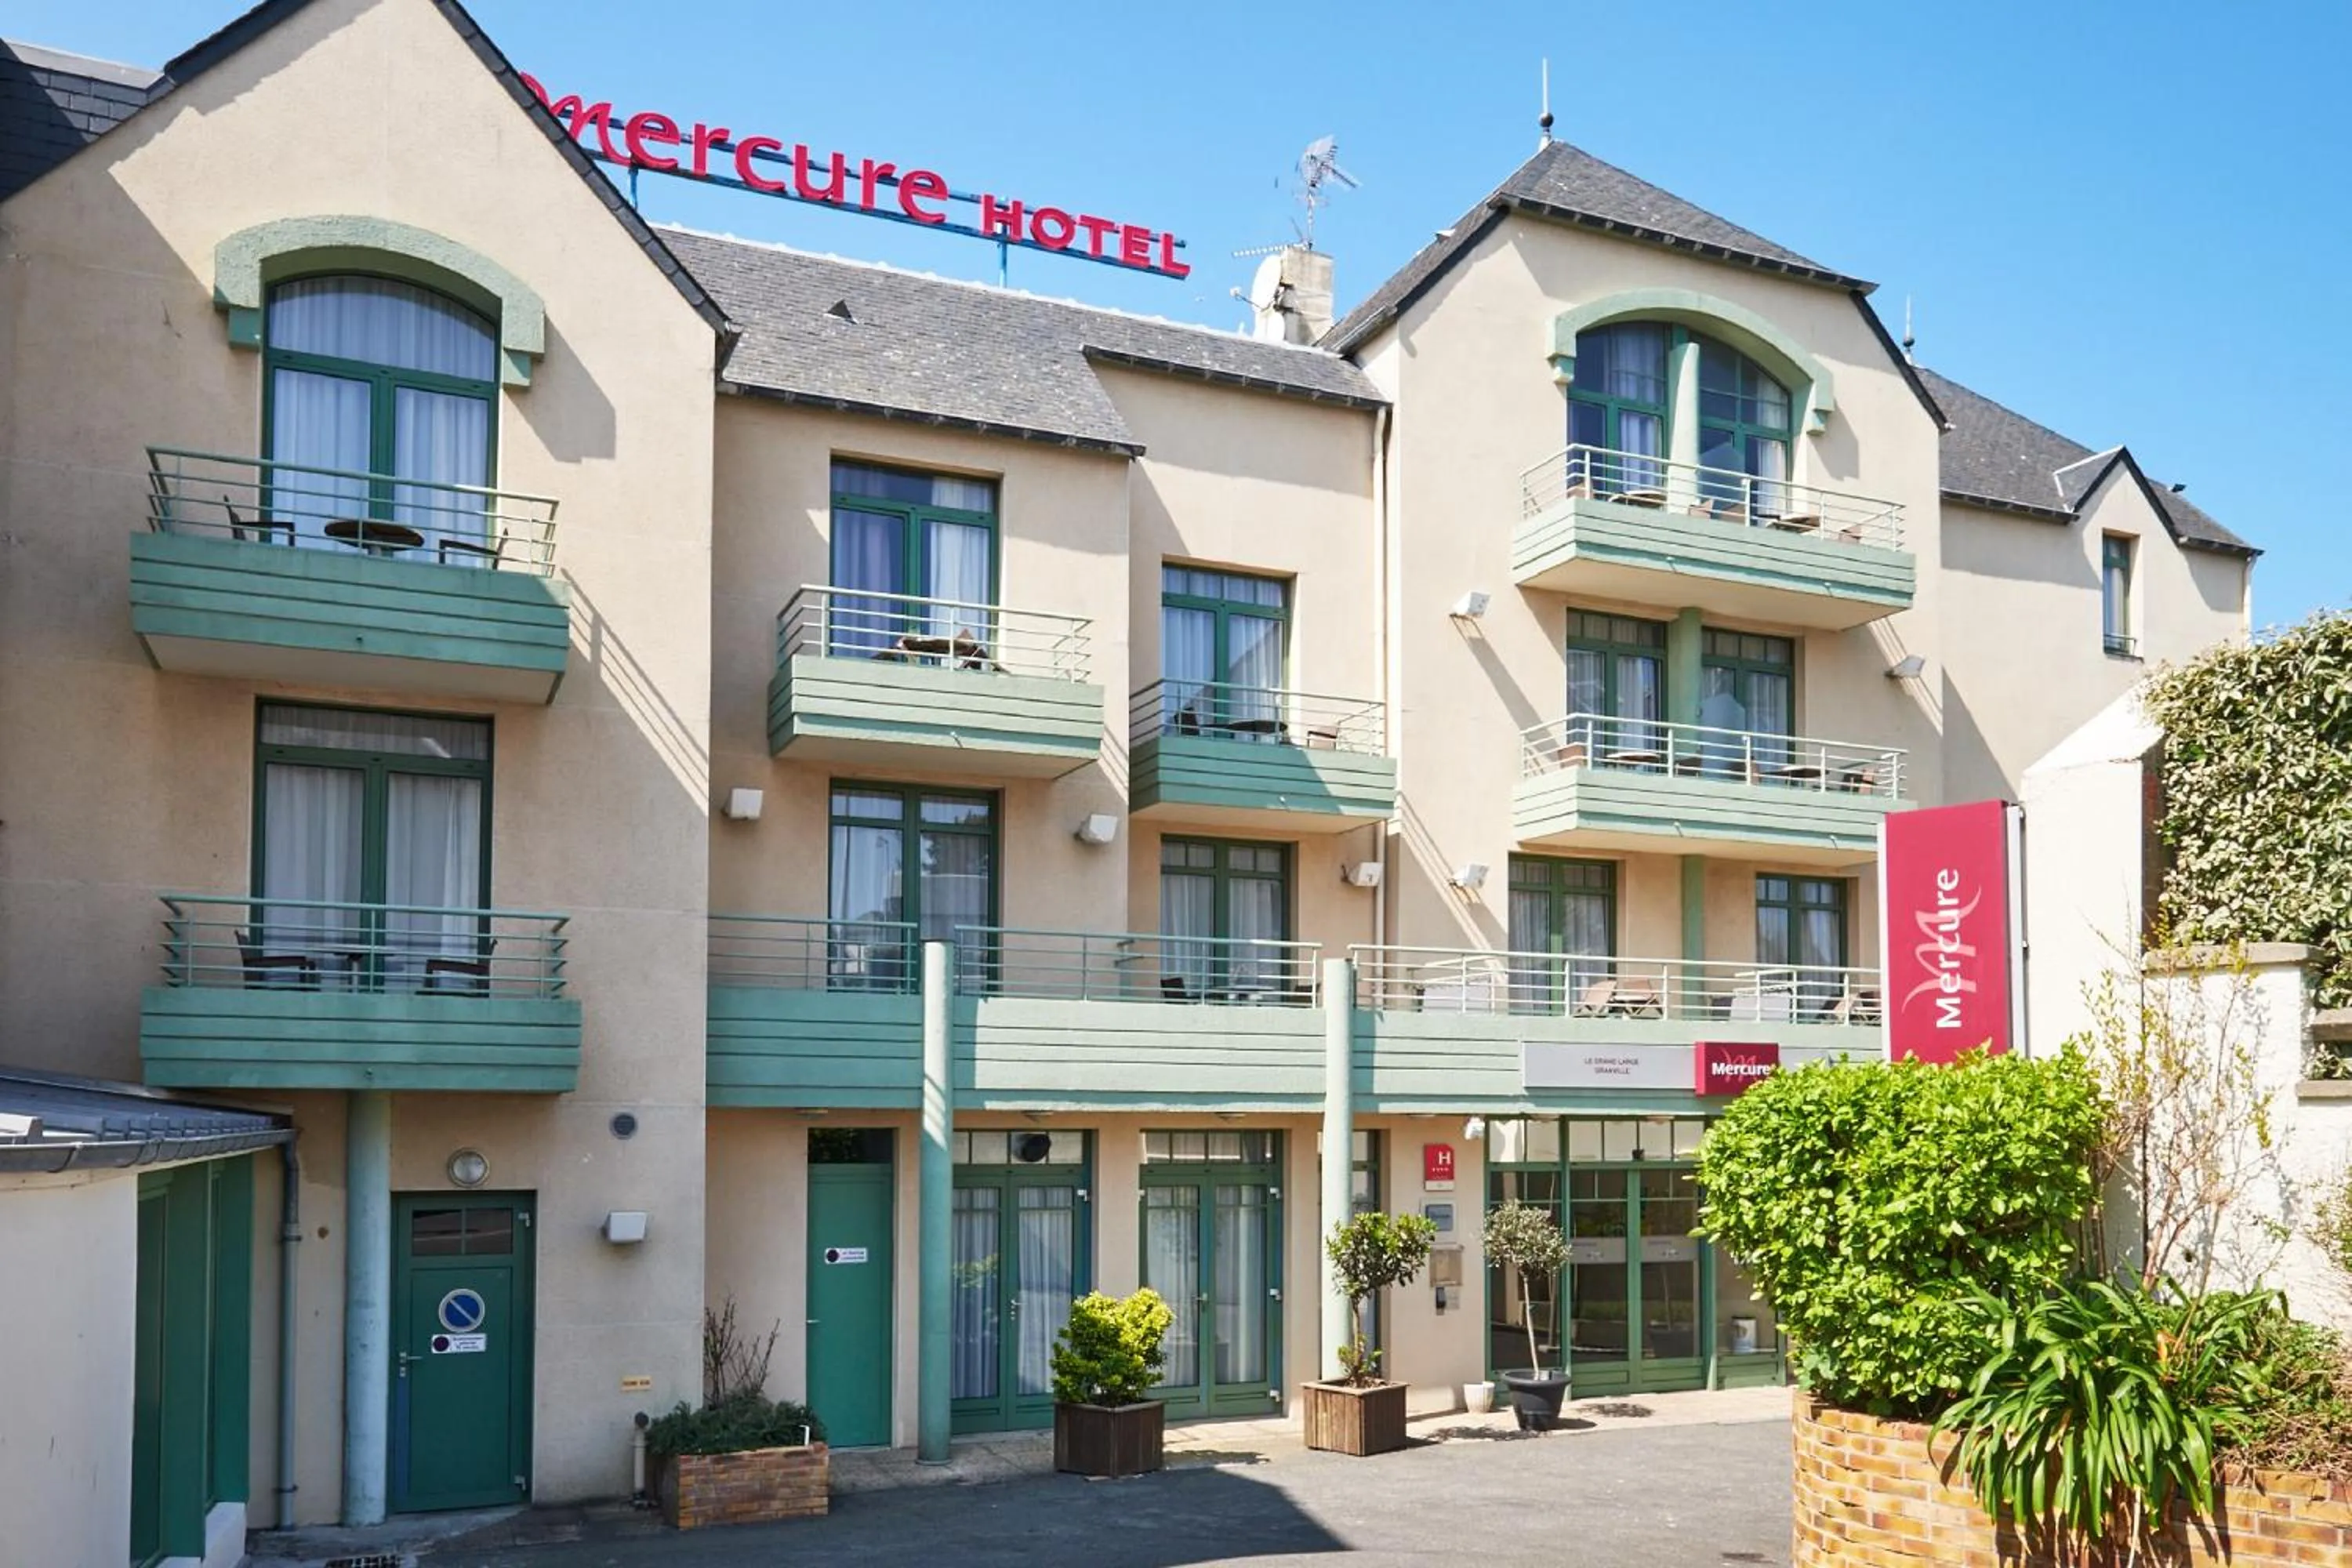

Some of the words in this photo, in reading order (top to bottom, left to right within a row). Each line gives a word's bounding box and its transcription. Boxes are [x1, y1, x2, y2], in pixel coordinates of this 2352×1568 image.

[982, 194, 1190, 276] HOTEL
[1936, 868, 1962, 1029] Mercure
[1711, 1062, 1770, 1076] Mercure
[1439, 1151, 1450, 1164] H
